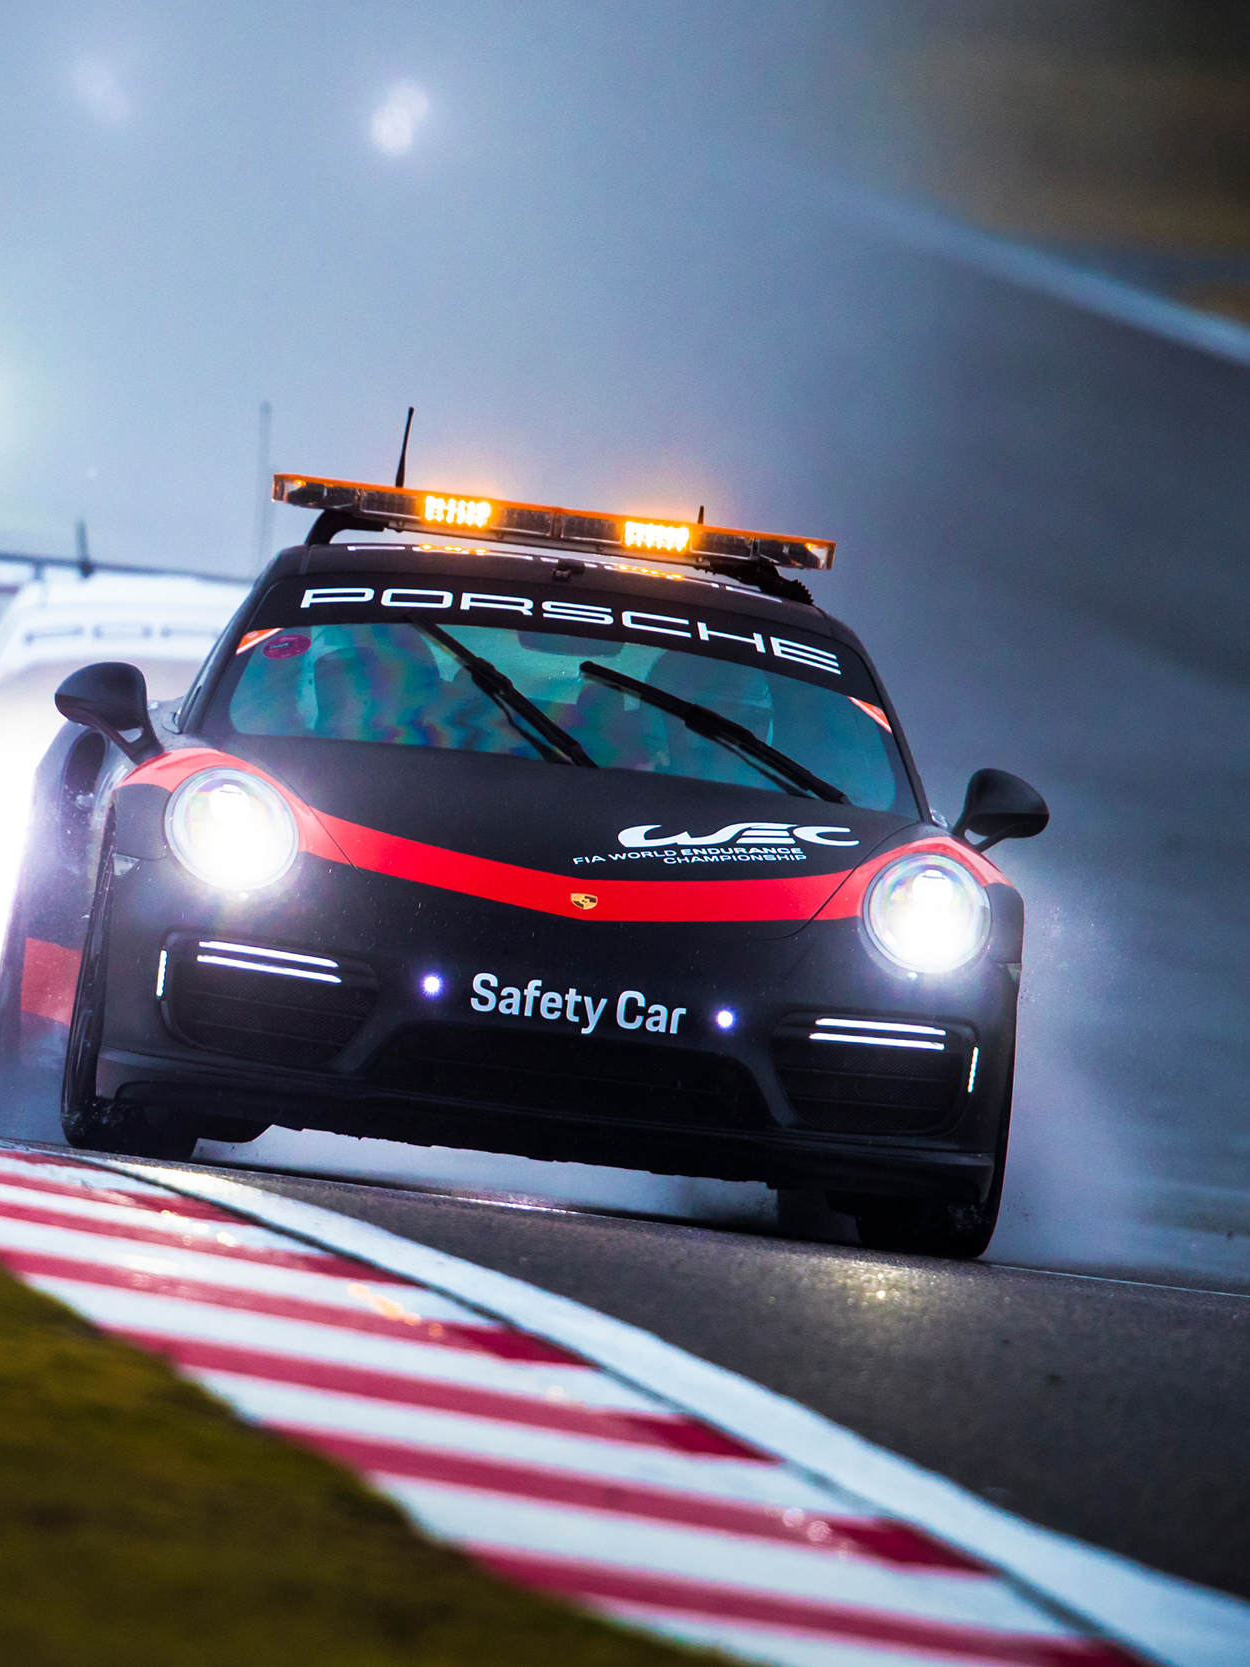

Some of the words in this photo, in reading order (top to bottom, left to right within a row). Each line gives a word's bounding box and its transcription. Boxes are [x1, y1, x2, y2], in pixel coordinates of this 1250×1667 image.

[300, 587, 841, 675] PORSCHE
[618, 822, 860, 847] WEC
[572, 855, 607, 865] FIA
[608, 850, 678, 861] WORLD
[680, 847, 804, 856] ENDURANCE
[663, 855, 808, 864] CHAMPIONSHIP
[470, 972, 608, 1035] Safety
[616, 990, 687, 1035] Car
